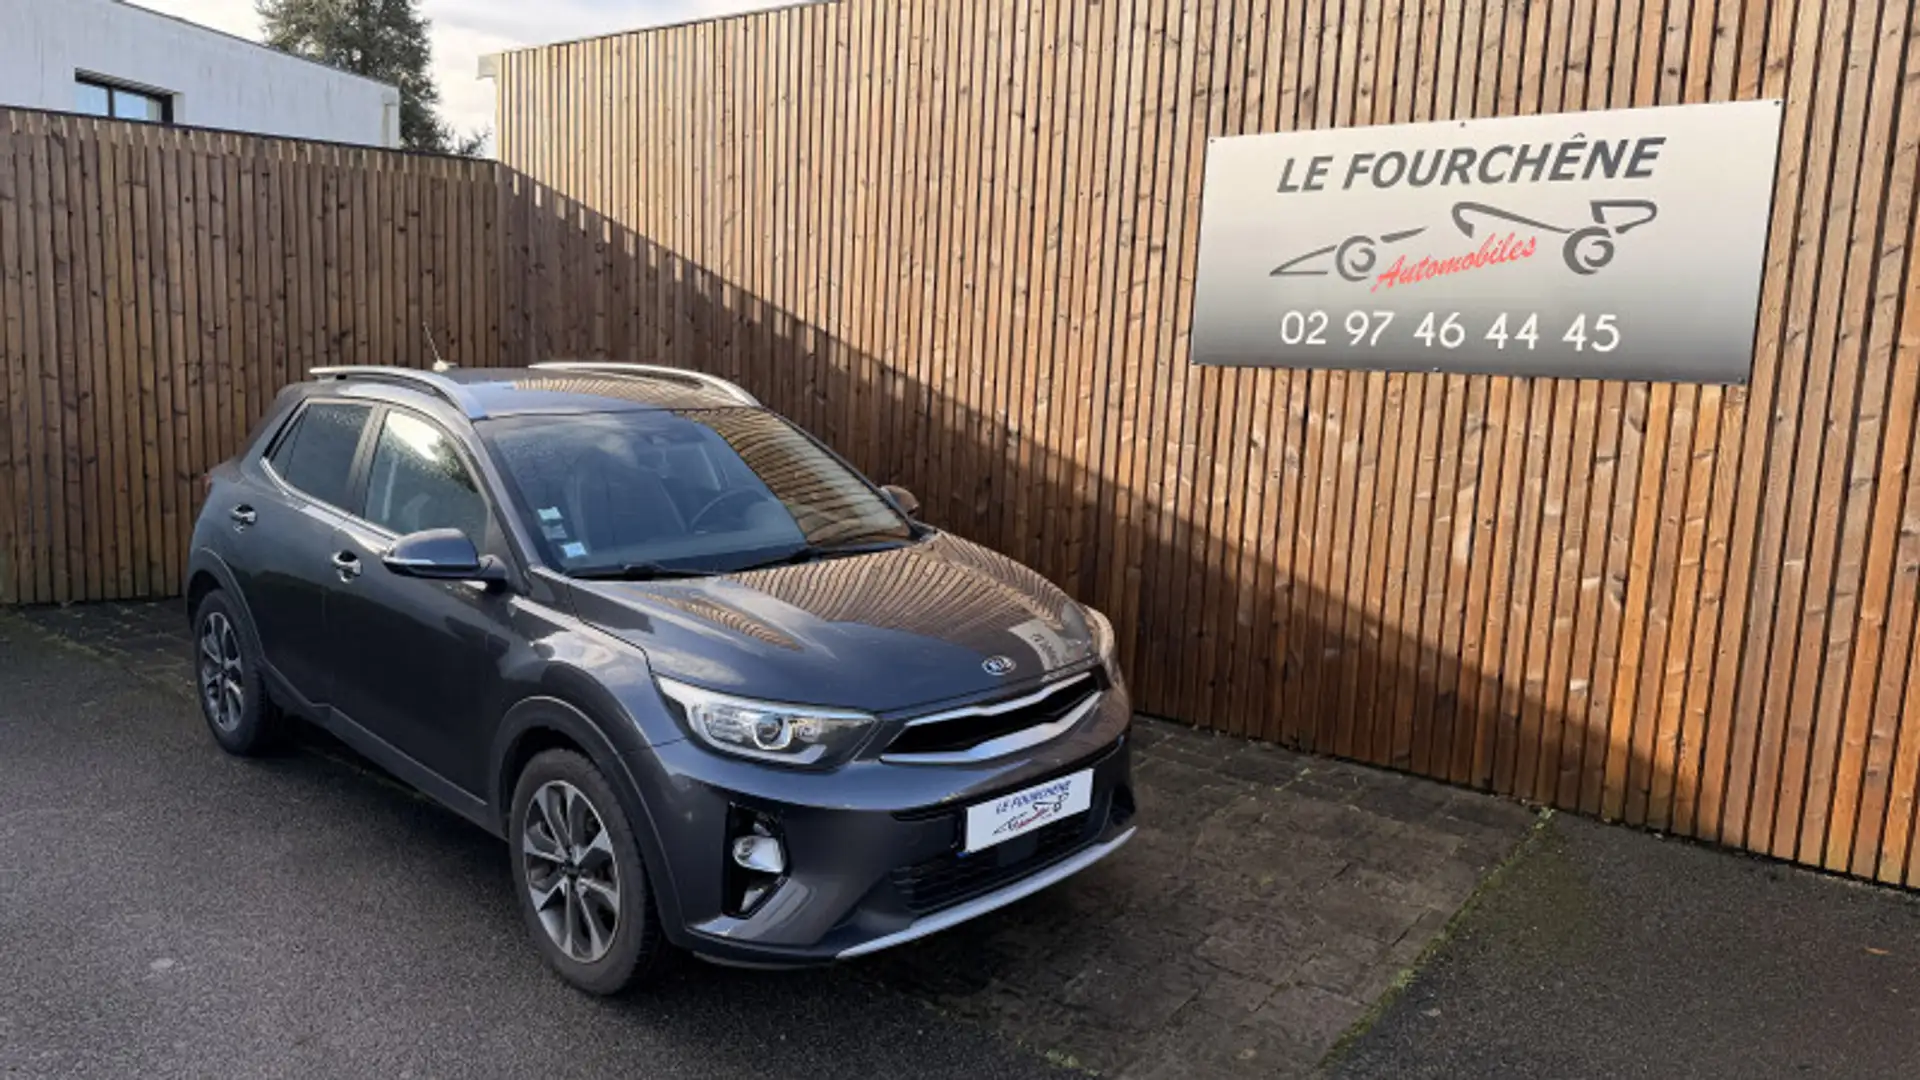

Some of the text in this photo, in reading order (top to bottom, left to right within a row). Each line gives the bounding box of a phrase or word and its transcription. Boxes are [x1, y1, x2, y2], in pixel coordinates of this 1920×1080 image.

[1276, 132, 1668, 194] LE FOURCHÊNE
[1370, 231, 1537, 294] Automobiles
[1281, 309, 1621, 353] 02 97 46 44 45
